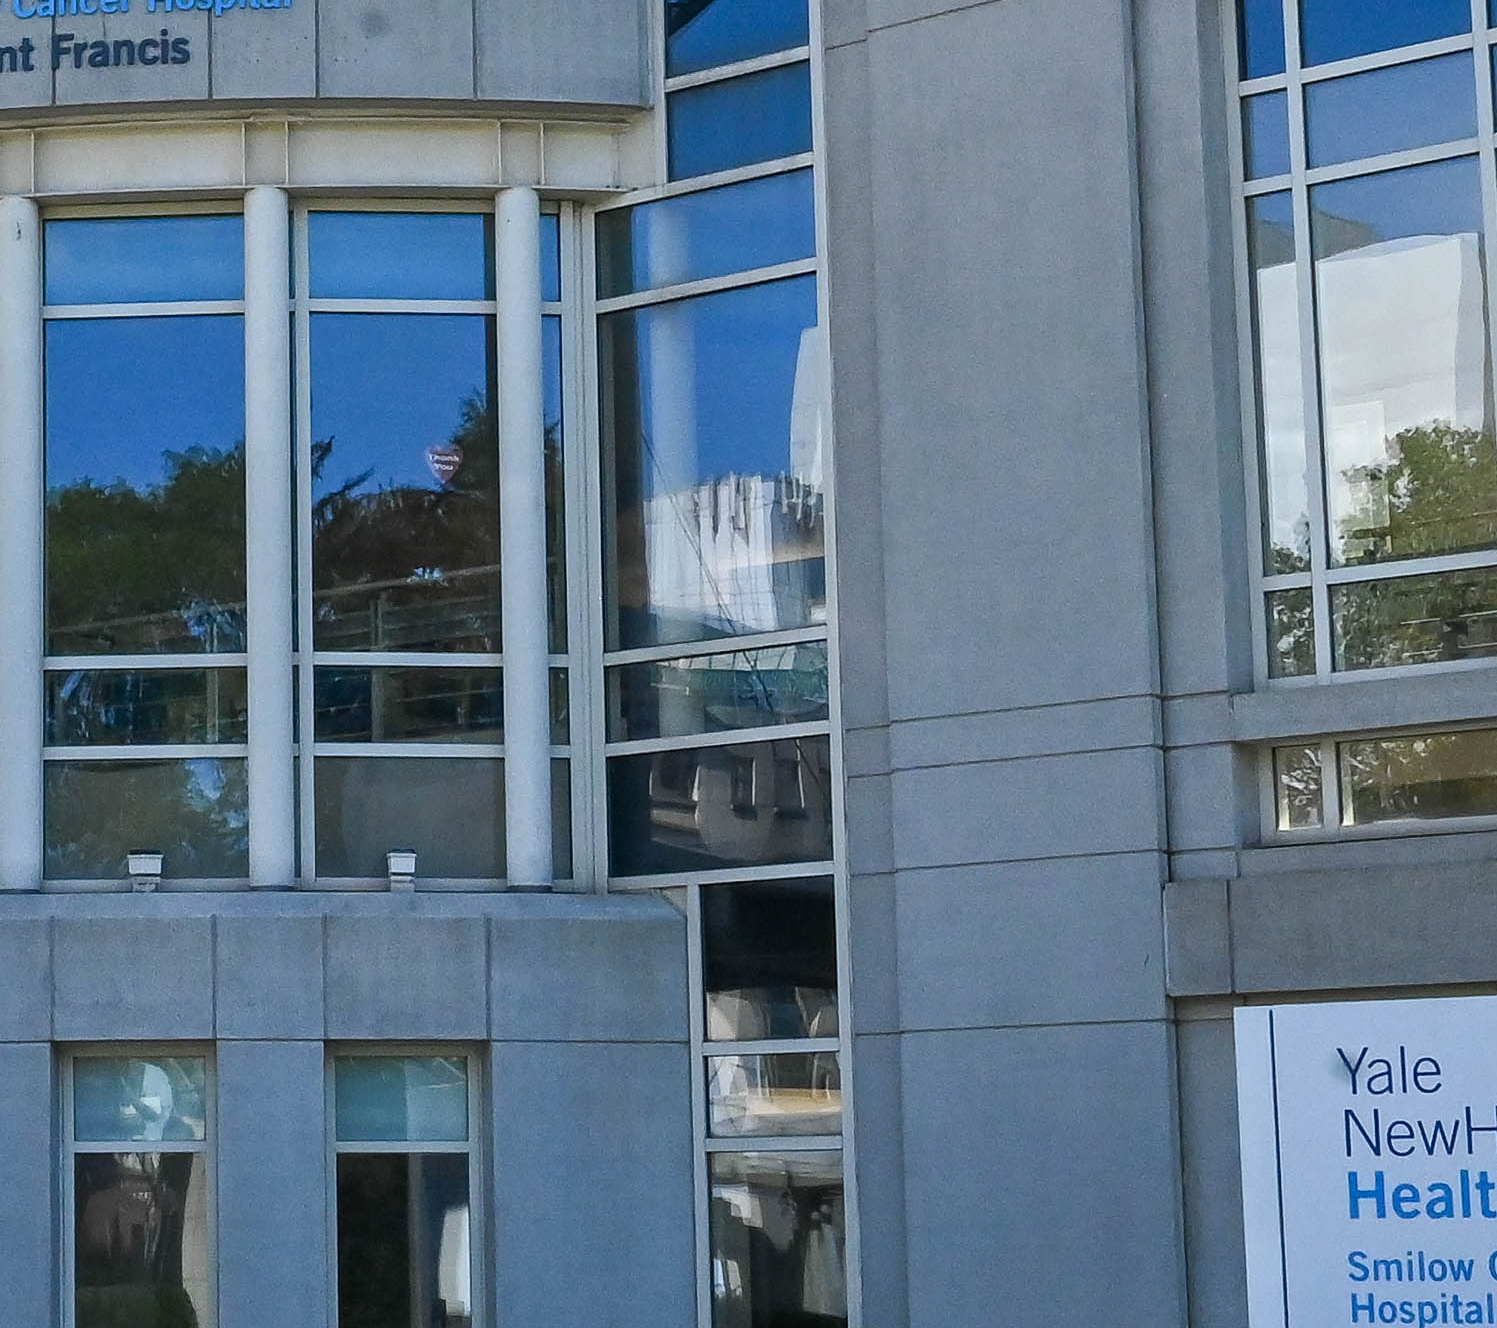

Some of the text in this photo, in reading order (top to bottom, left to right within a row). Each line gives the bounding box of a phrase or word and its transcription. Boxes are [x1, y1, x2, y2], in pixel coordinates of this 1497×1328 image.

[50, 28, 191, 70] Francis
[1336, 1045, 1443, 1095] Yale
[1347, 1250, 1474, 1282] Smilow
